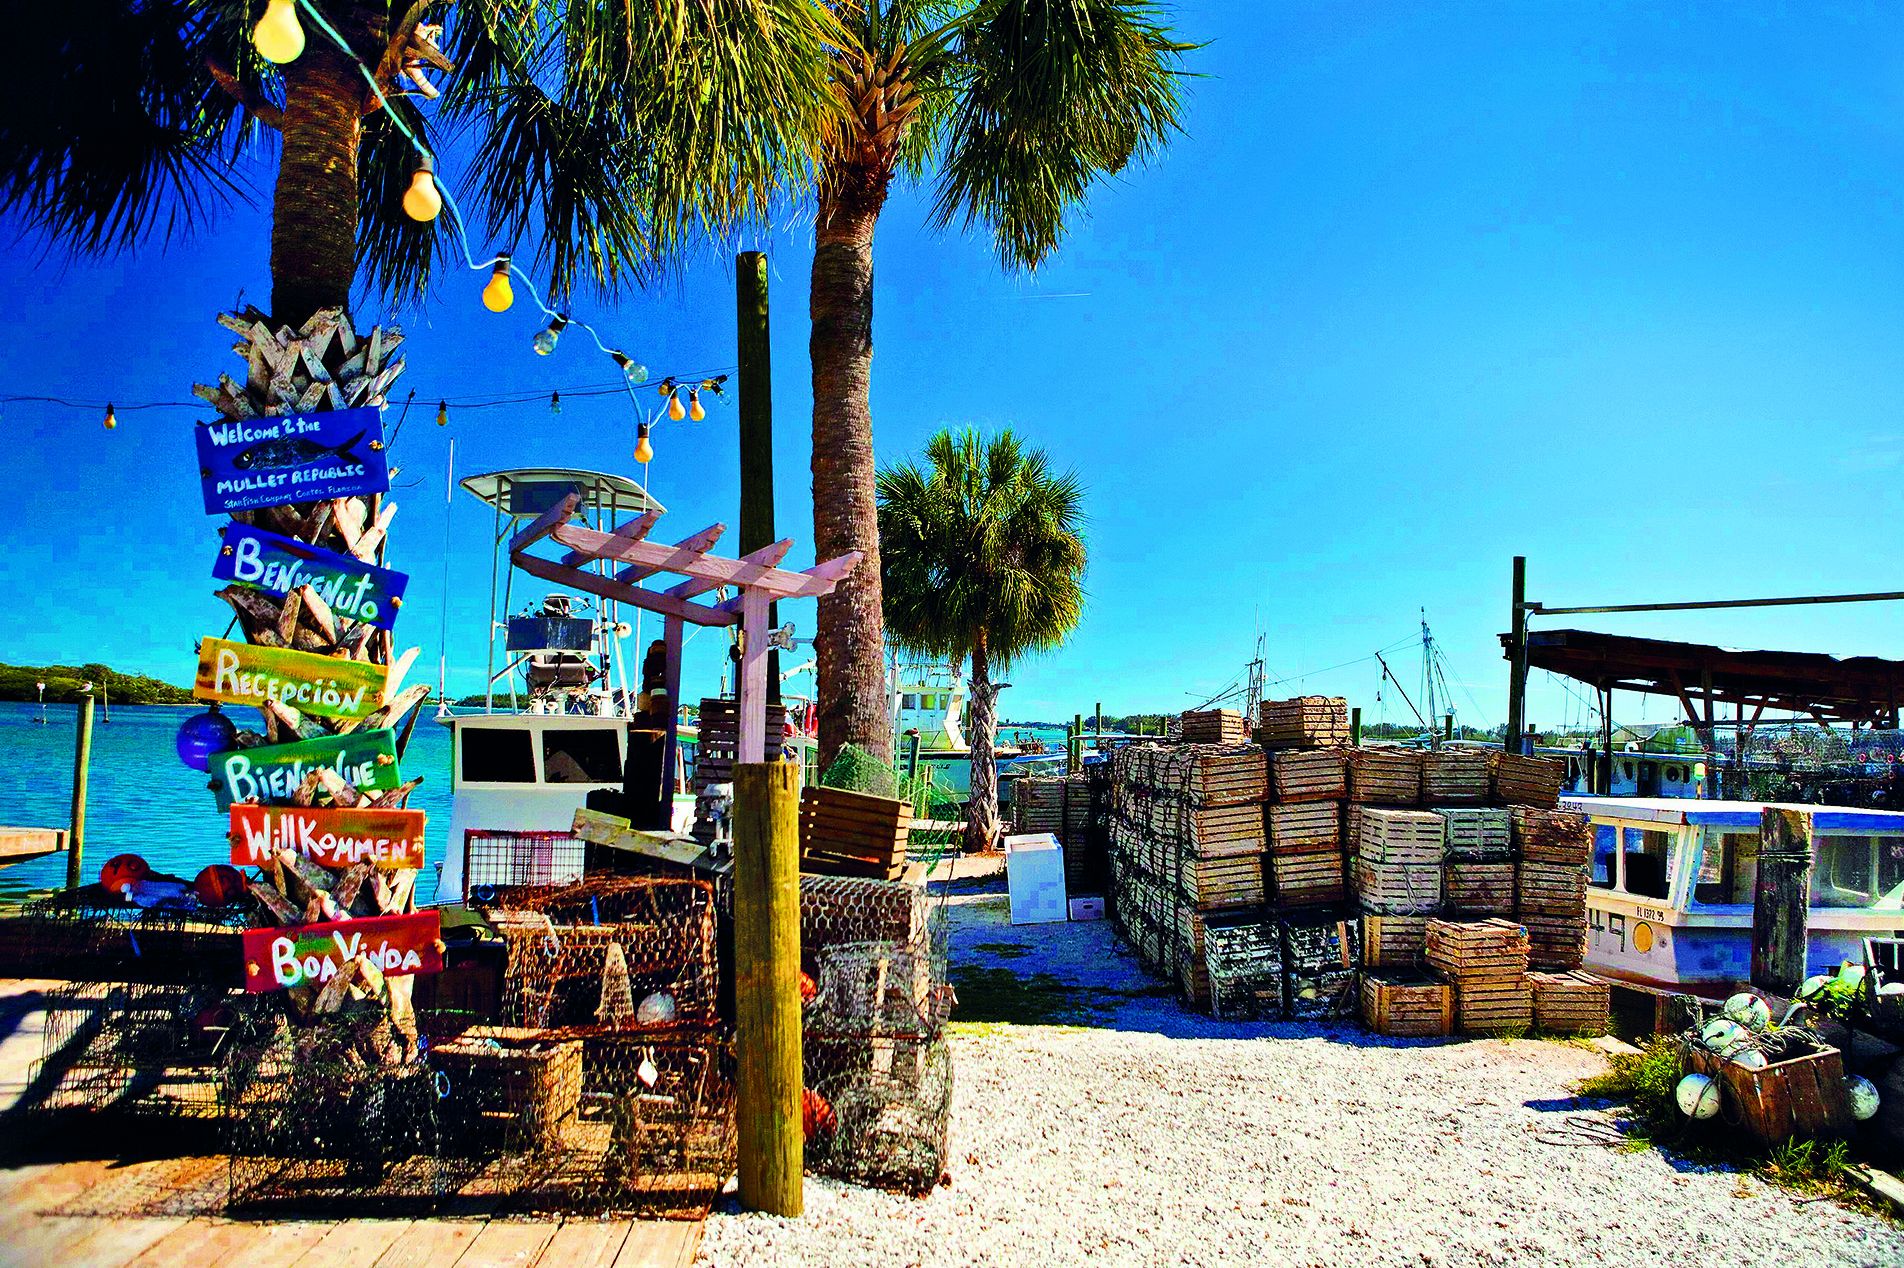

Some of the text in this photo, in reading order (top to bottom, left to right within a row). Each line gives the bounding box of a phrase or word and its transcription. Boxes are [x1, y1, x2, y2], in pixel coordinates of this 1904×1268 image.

[282, 418, 295, 434] 2
[217, 464, 365, 494] MULLET REPUBLIC
[225, 750, 376, 804] BIENUE
